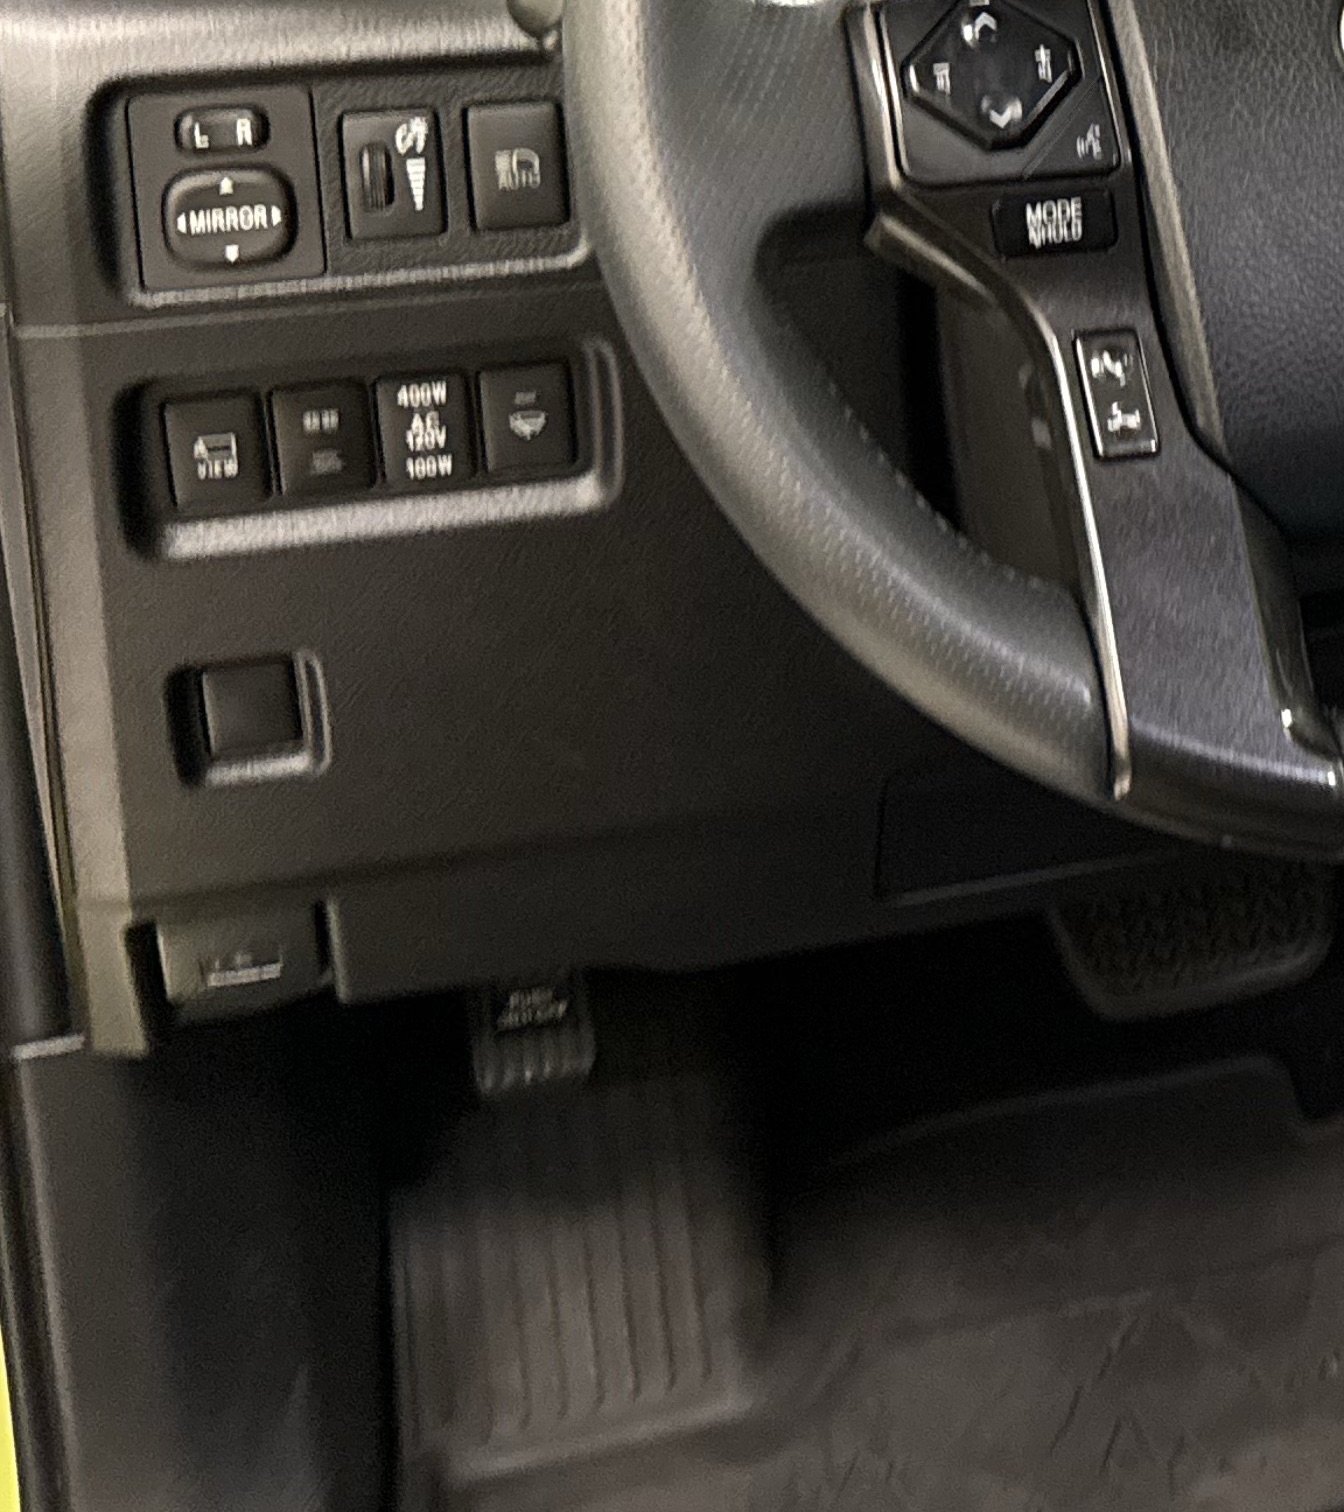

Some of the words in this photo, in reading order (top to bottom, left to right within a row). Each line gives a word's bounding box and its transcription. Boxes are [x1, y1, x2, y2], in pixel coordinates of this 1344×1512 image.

[189, 204, 268, 236] MIRROR
[1025, 197, 1082, 221] MODE
[406, 453, 452, 480] 100W
